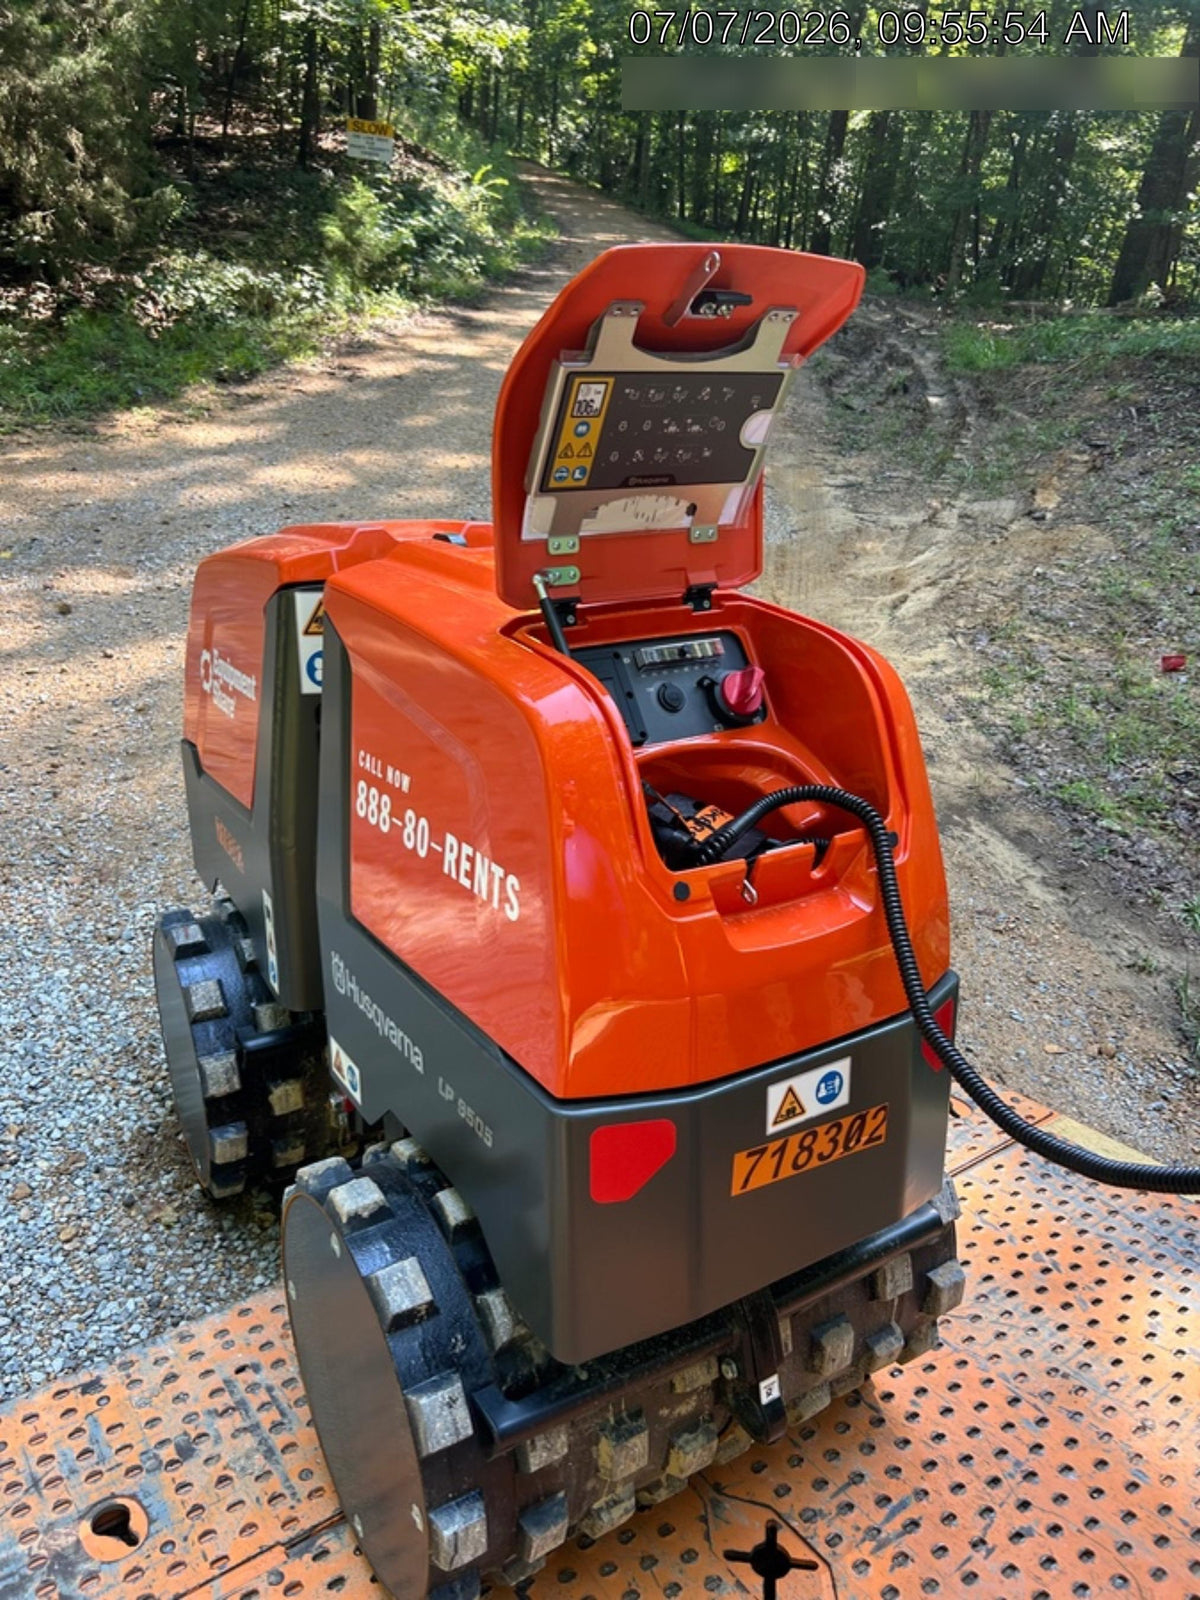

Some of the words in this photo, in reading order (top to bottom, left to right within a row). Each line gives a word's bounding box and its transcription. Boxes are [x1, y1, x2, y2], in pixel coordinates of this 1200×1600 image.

[352, 120, 388, 136] SLOW
[358, 750, 383, 779] CALL
[386, 765, 411, 793] NOW
[356, 779, 520, 922] 888-80-RENTS
[345, 969, 425, 1075] Husqvarna
[438, 1076, 454, 1101] LP
[457, 1097, 493, 1148] 8505
[740, 1105, 889, 1190] 718302
